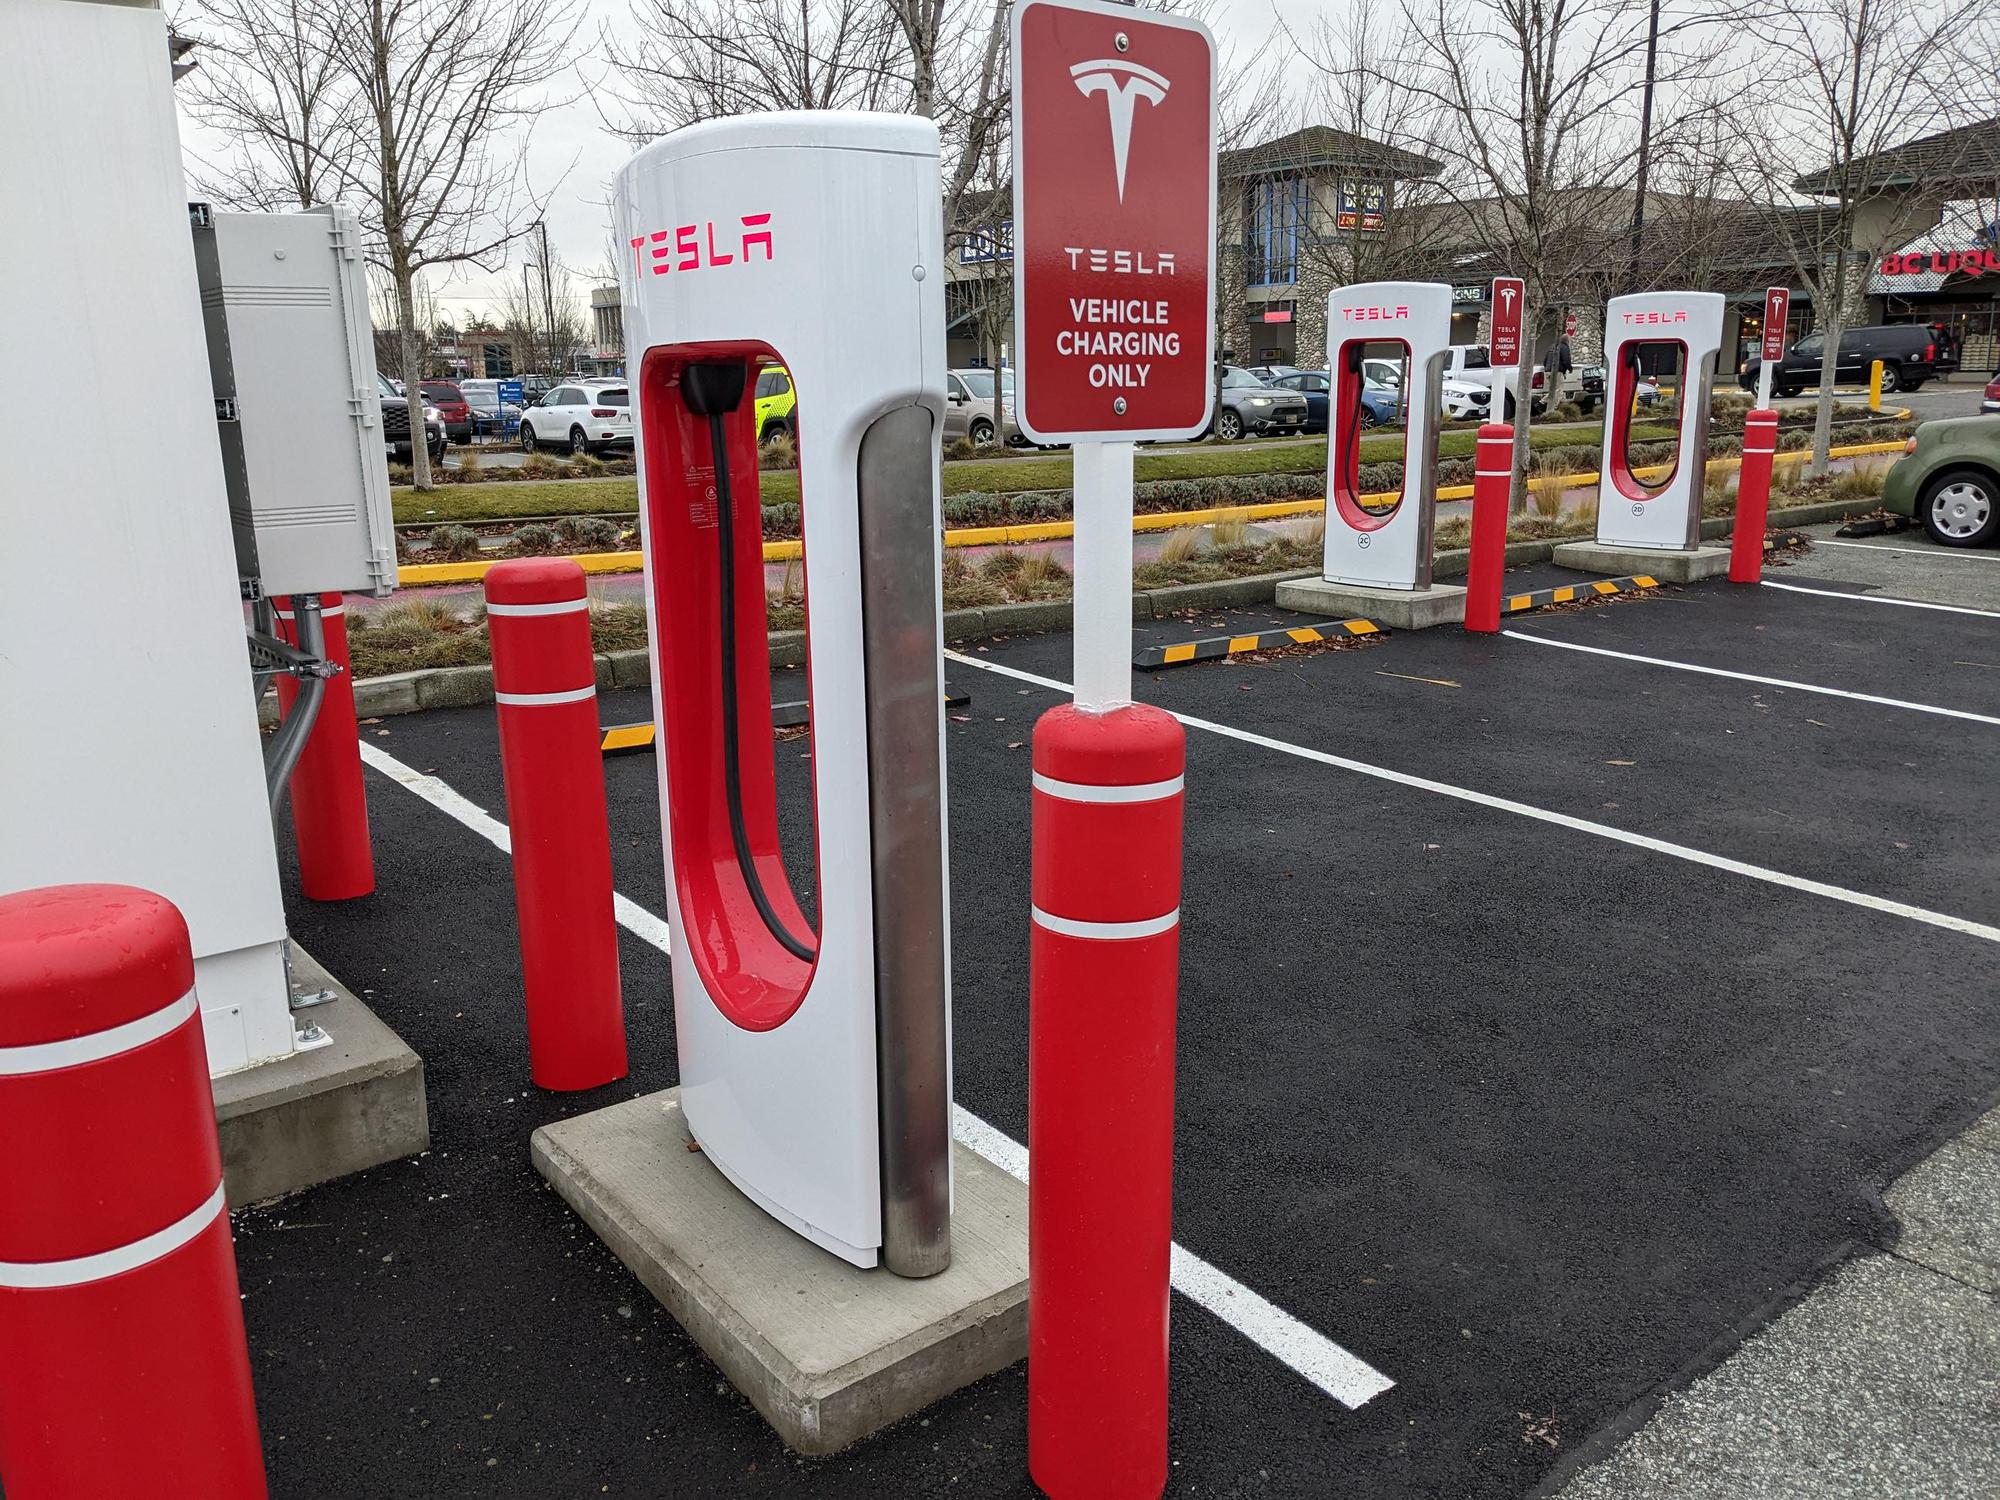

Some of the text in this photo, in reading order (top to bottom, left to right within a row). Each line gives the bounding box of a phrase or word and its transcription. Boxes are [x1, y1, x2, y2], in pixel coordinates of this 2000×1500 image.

[630, 213, 773, 279] TESLA
[1064, 247, 1175, 275] TESLA
[1880, 252, 1923, 276] BC
[1069, 298, 1169, 324] VEHICLE
[1343, 306, 1408, 320] TESLA
[1623, 311, 1687, 325] TESLA
[1056, 331, 1180, 355] CHARGING
[1089, 363, 1151, 388] ONLY
